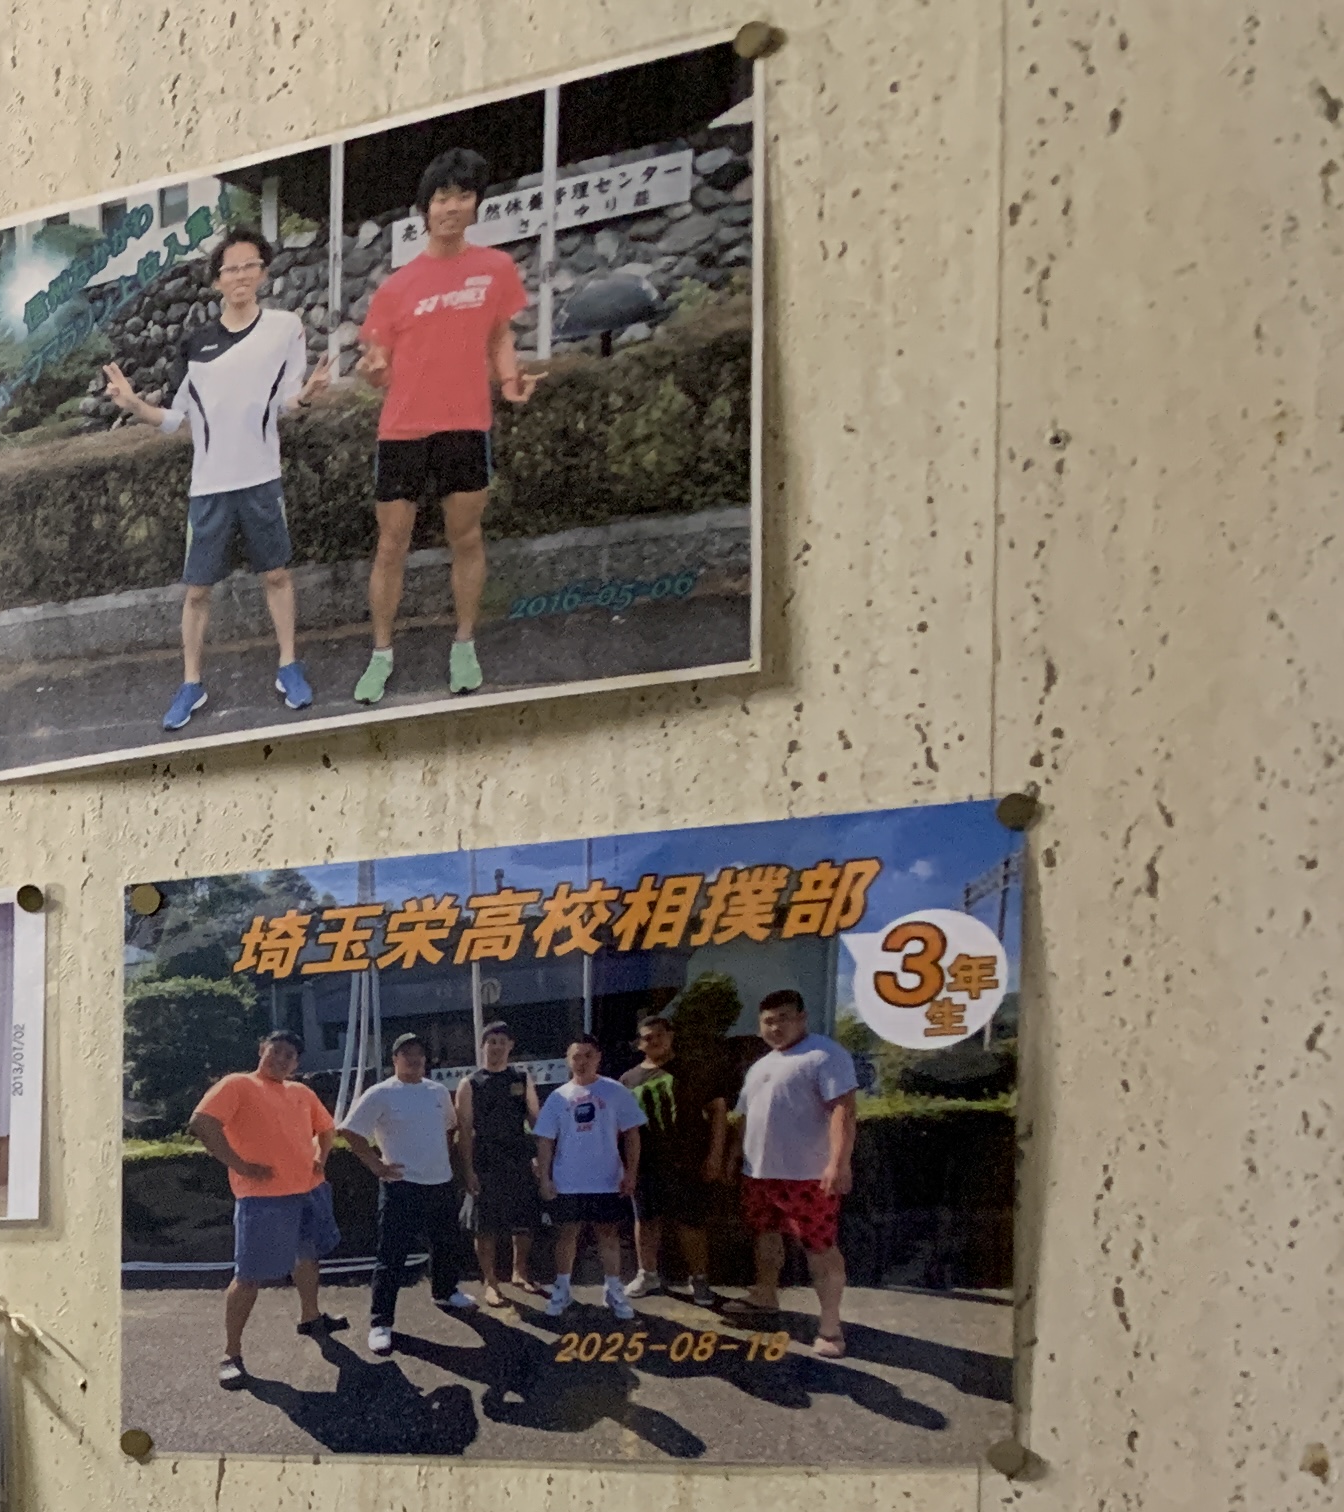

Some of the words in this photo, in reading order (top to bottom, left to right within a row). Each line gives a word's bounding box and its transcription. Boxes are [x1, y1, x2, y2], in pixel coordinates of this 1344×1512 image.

[232, 856, 885, 981] 埼玉栄高校相撲部
[554, 1331, 791, 1365] 2025-08-18
